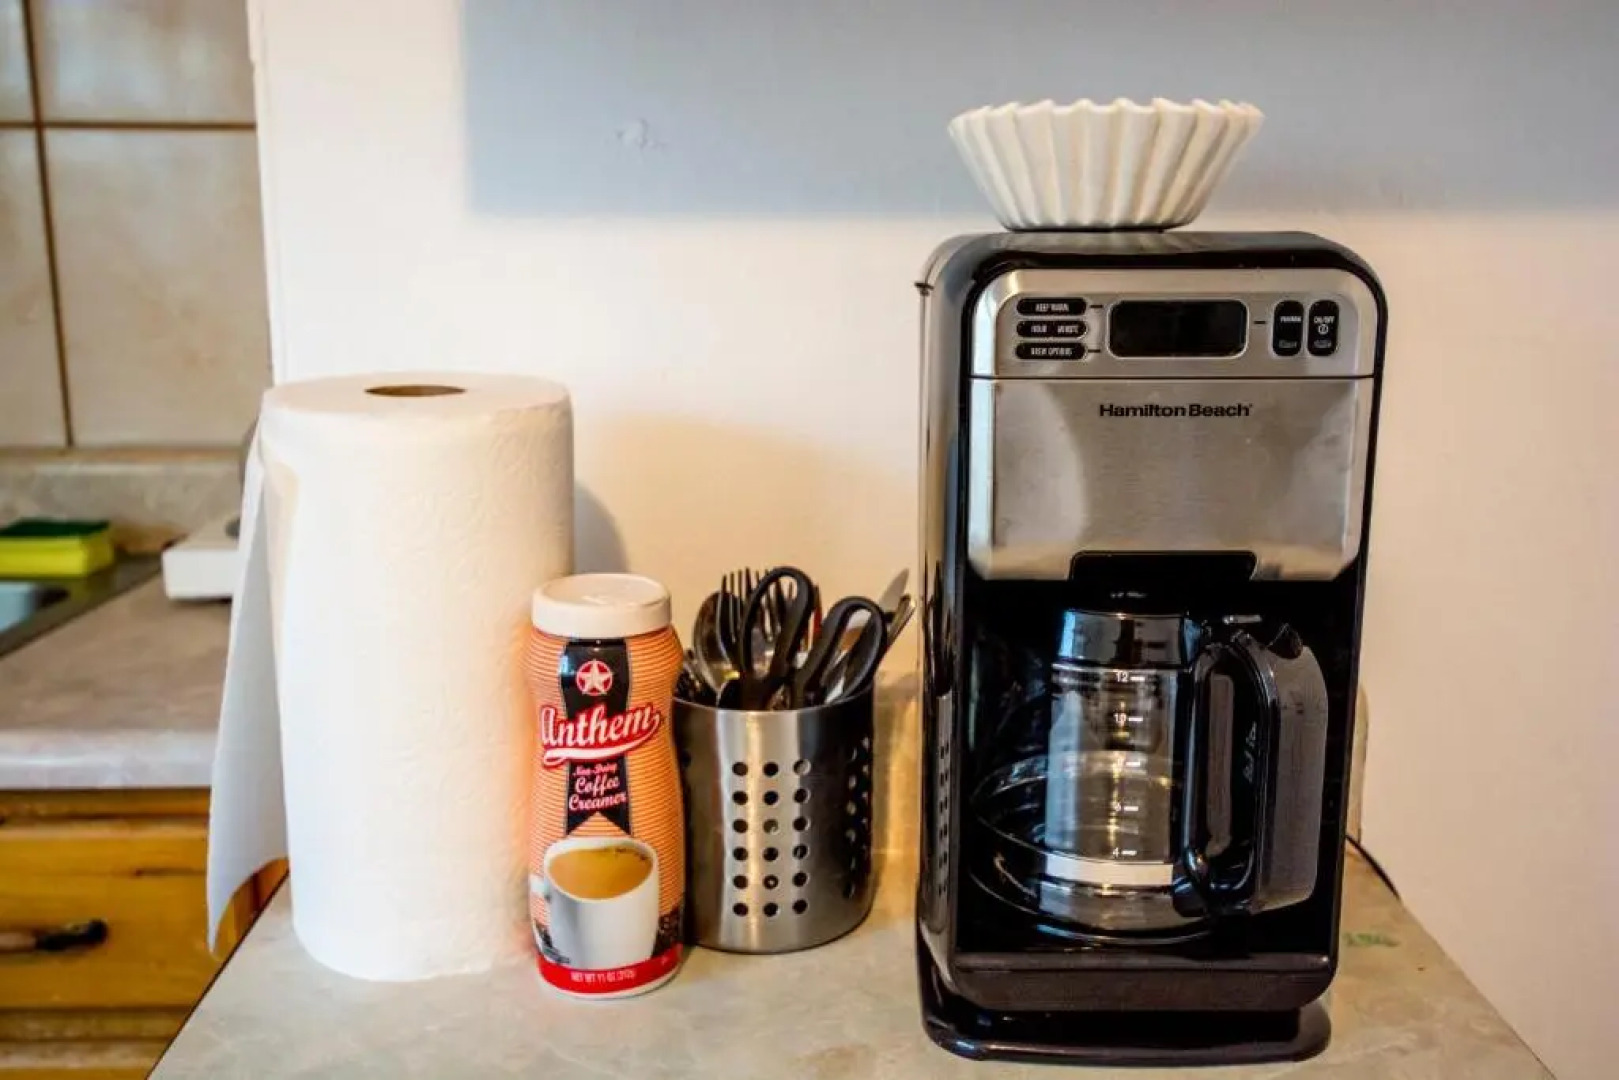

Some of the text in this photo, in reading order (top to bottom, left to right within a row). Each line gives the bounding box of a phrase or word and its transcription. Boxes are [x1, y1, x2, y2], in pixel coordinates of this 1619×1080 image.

[1099, 403, 1250, 417] Hamilton Beach
[1115, 670, 1129, 683] 12
[541, 704, 661, 765] Anthem
[575, 773, 620, 797] Coffee
[568, 792, 627, 811] Creamer
[1112, 847, 1120, 859] 4
